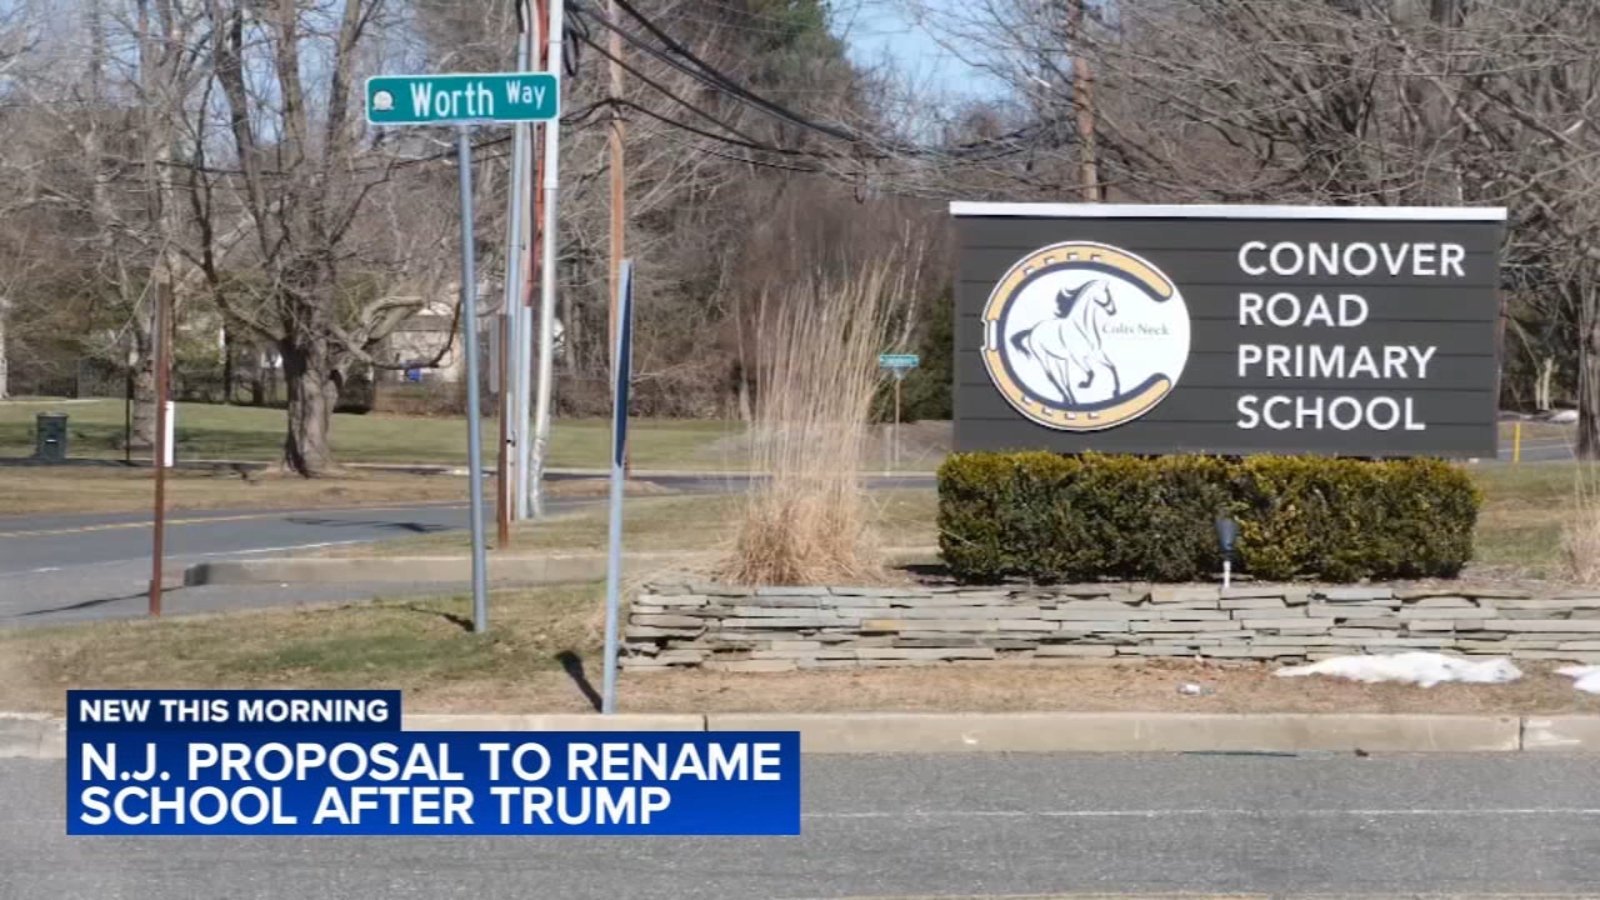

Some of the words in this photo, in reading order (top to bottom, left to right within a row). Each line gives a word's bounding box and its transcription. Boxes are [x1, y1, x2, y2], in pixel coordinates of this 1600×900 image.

[409, 81, 494, 118] Worth
[506, 79, 546, 110] Way
[1237, 240, 1466, 278] CONOVER
[1238, 292, 1370, 328] ROAD
[1102, 323, 1135, 335] Colts
[1138, 324, 1170, 335] Neck
[1237, 343, 1437, 380] PRIMARY
[1236, 394, 1426, 431] SCHOOL
